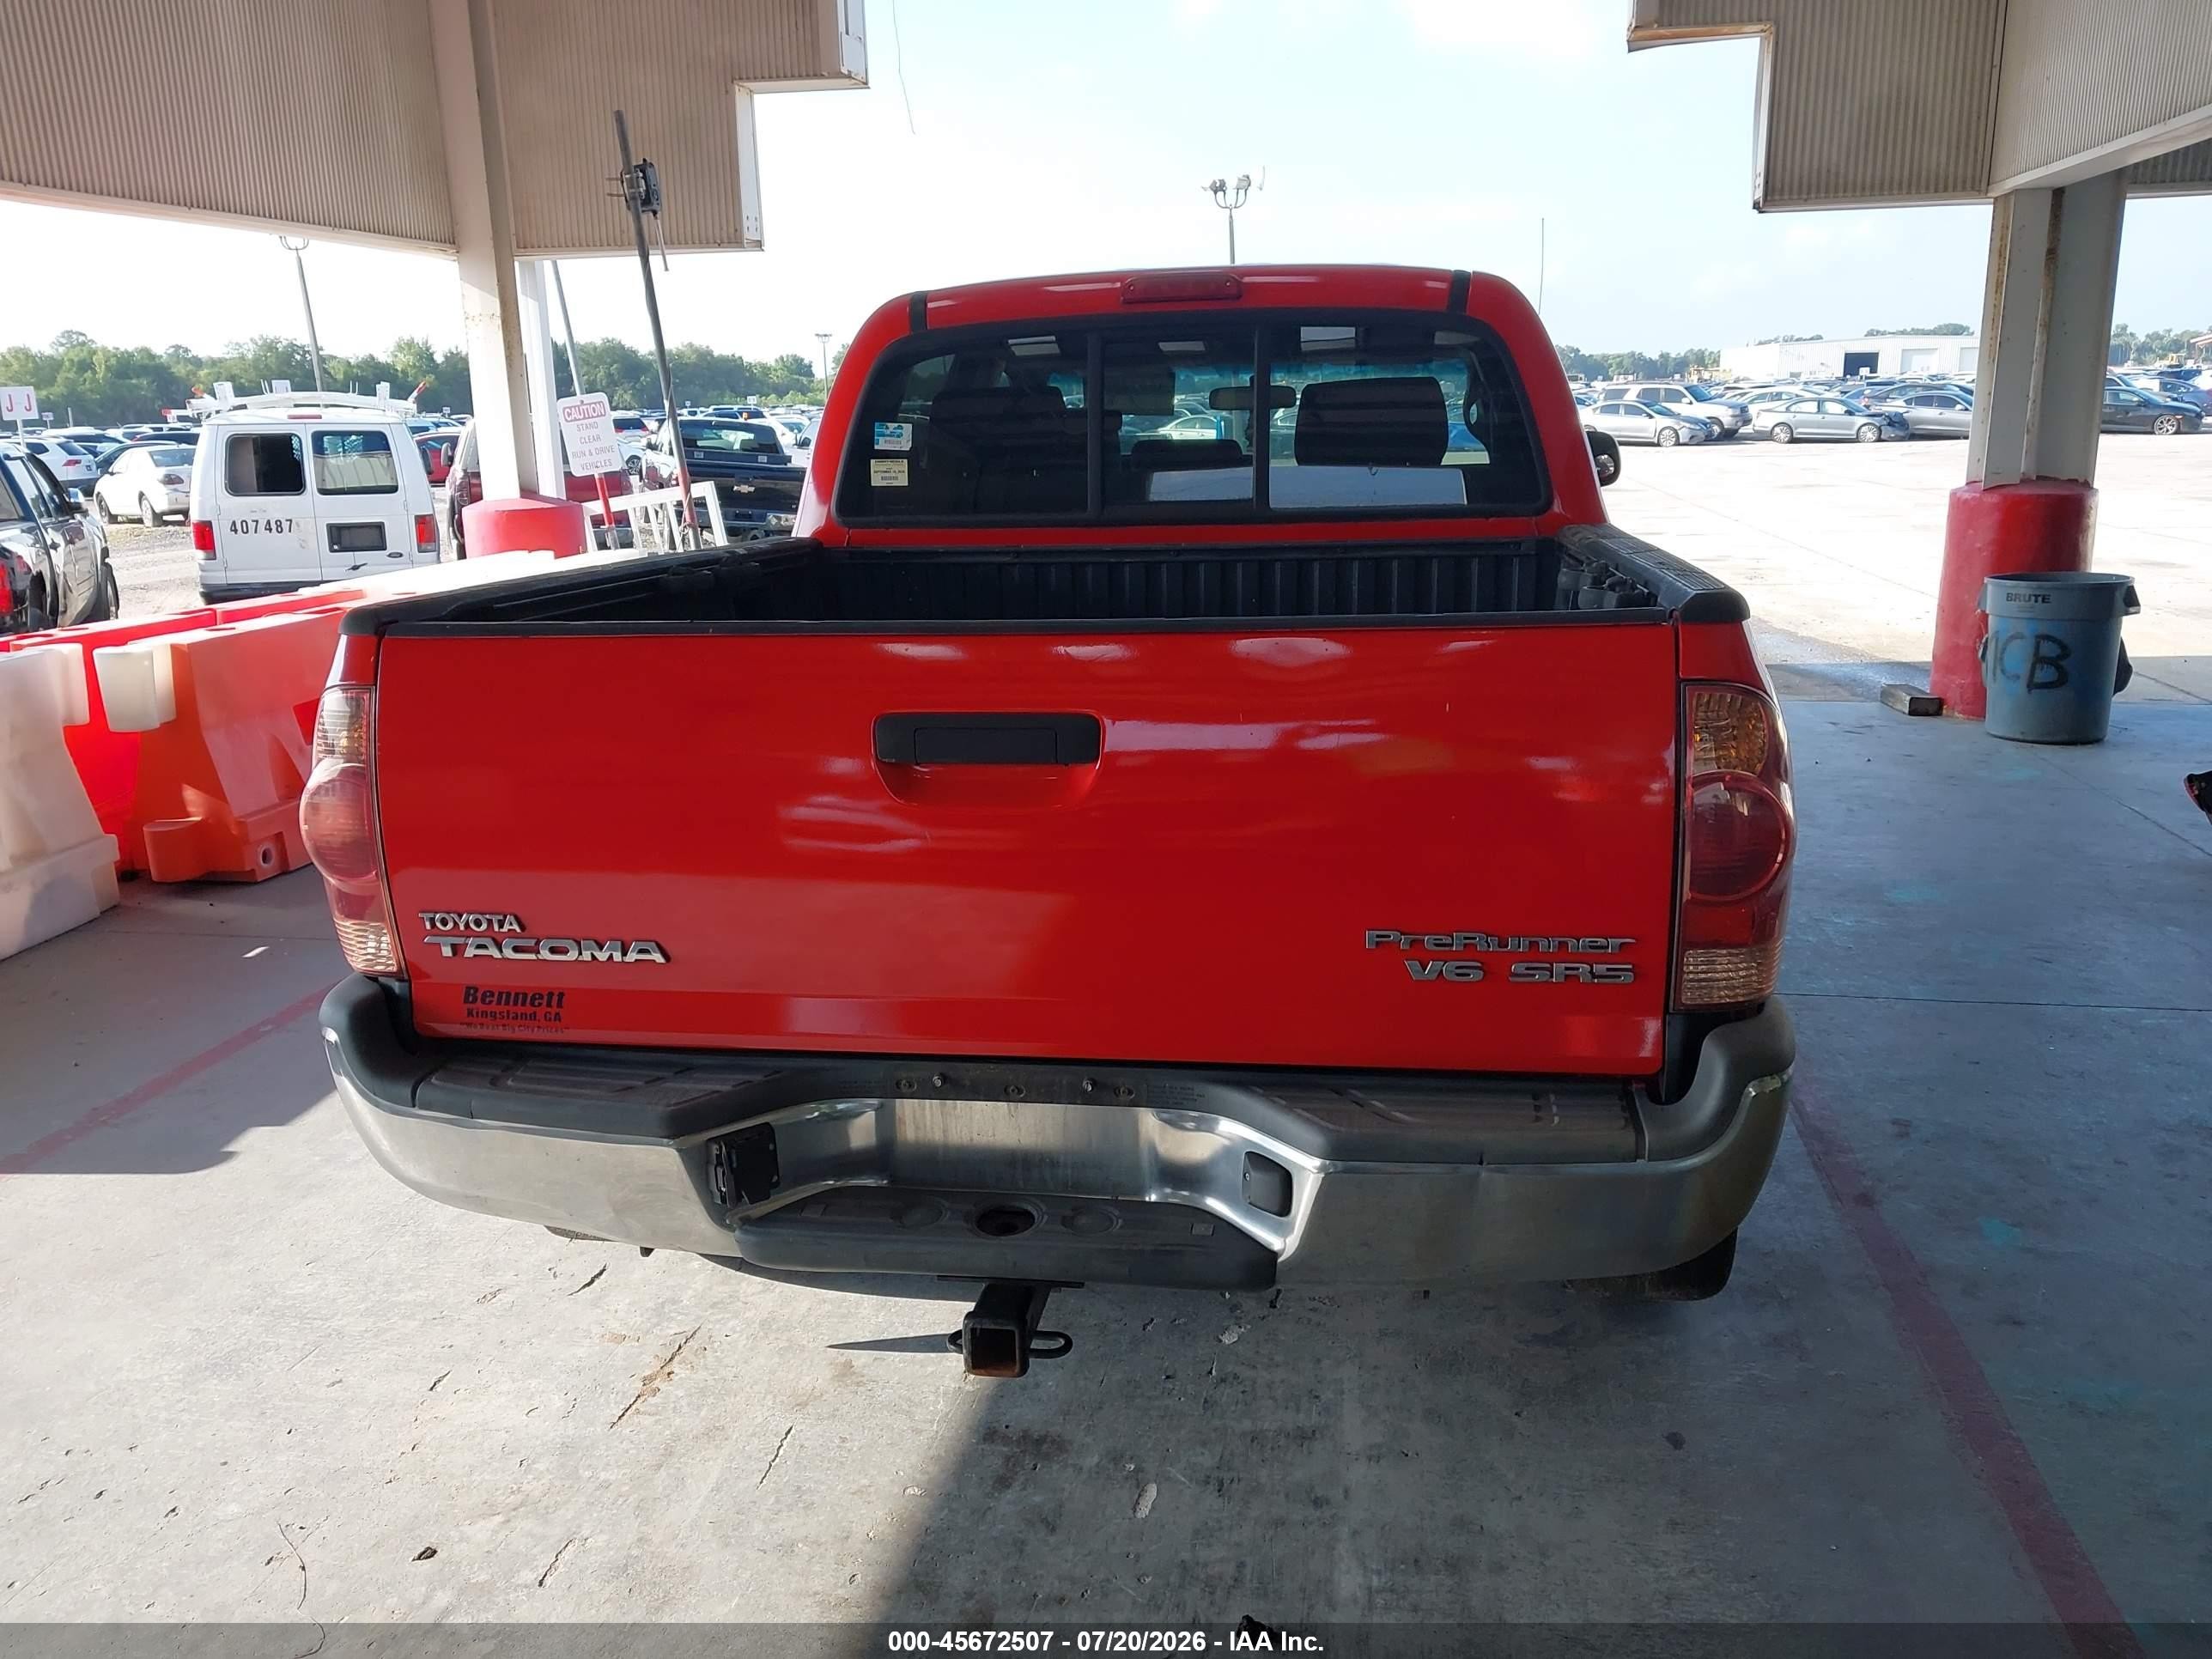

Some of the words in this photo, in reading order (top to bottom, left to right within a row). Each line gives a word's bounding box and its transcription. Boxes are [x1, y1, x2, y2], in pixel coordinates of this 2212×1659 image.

[563, 403, 605, 421] CAUTION
[576, 422, 599, 432] STAND
[579, 434, 601, 445] CLEAR
[571, 451, 586, 459] RUN
[595, 446, 616, 455] DRIVE
[580, 459, 612, 471] VEHICLES
[2006, 592, 2052, 604] BRUTE
[418, 912, 526, 933] TOYOTA
[423, 934, 671, 964] TACOMA
[1365, 929, 1637, 954] PreRunner
[1403, 959, 1485, 983] V6
[1508, 961, 1635, 984] SR5
[463, 986, 566, 1009] Bennett
[466, 1008, 541, 1023] Kingsland,
[544, 1011, 562, 1023] GA
